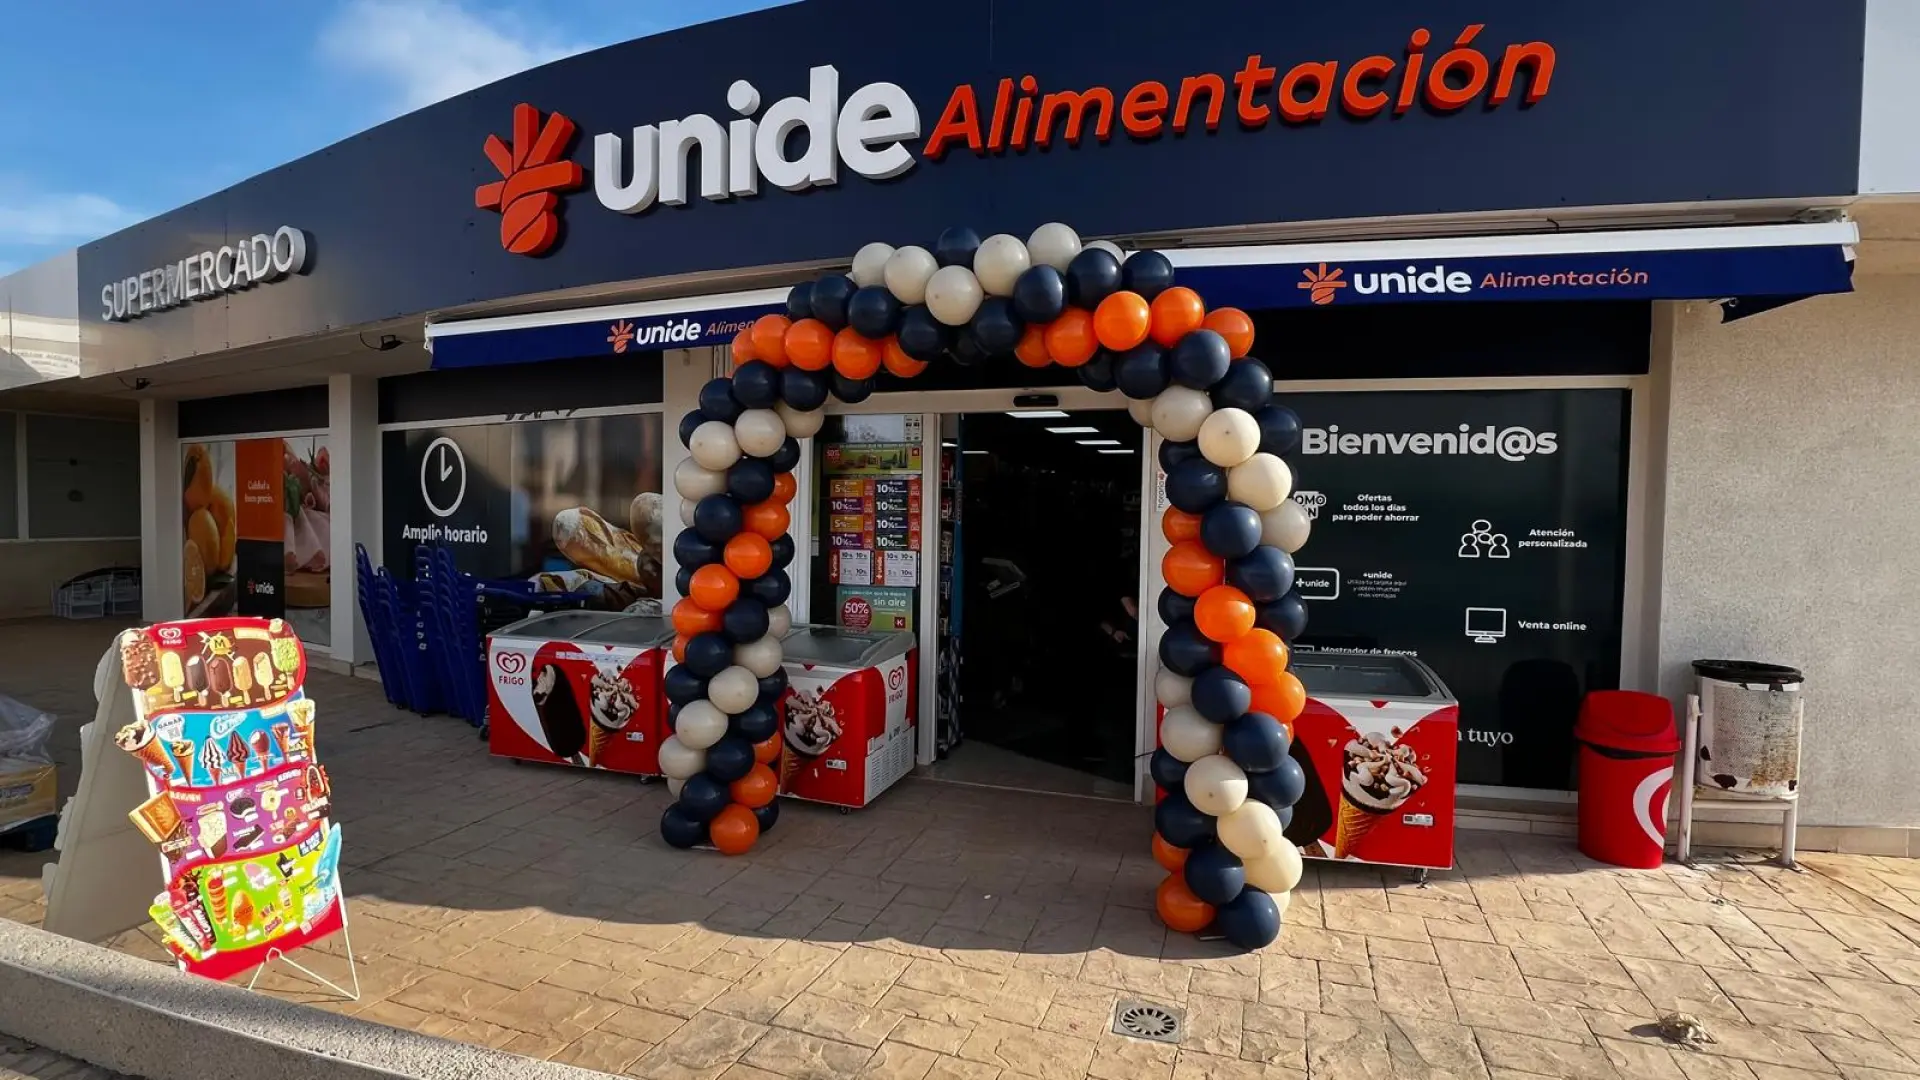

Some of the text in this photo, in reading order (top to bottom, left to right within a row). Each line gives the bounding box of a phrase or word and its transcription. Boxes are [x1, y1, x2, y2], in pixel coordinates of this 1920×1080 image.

[594, 24, 1556, 214] unide Alimentación
[102, 225, 306, 321] SUPERMERCADO
[1354, 265, 1649, 295] unide Alimentación
[636, 319, 755, 345] unide Alimen
[1302, 423, 1558, 462] Bienvenid@s
[1357, 494, 1392, 502] Ofertas
[1332, 514, 1353, 522] para
[1355, 513, 1382, 522] poder
[444, 525, 488, 544] horario
[1529, 528, 1575, 537] Atención
[1518, 539, 1588, 548] personalizada
[255, 581, 275, 595] unide
[1295, 577, 1330, 588] +unide
[844, 602, 869, 614] 50%
[873, 597, 906, 607] sin aire
[1518, 620, 1587, 631] Venta online
[498, 675, 524, 686] FRIGO
[1467, 728, 1514, 747] tuyo
